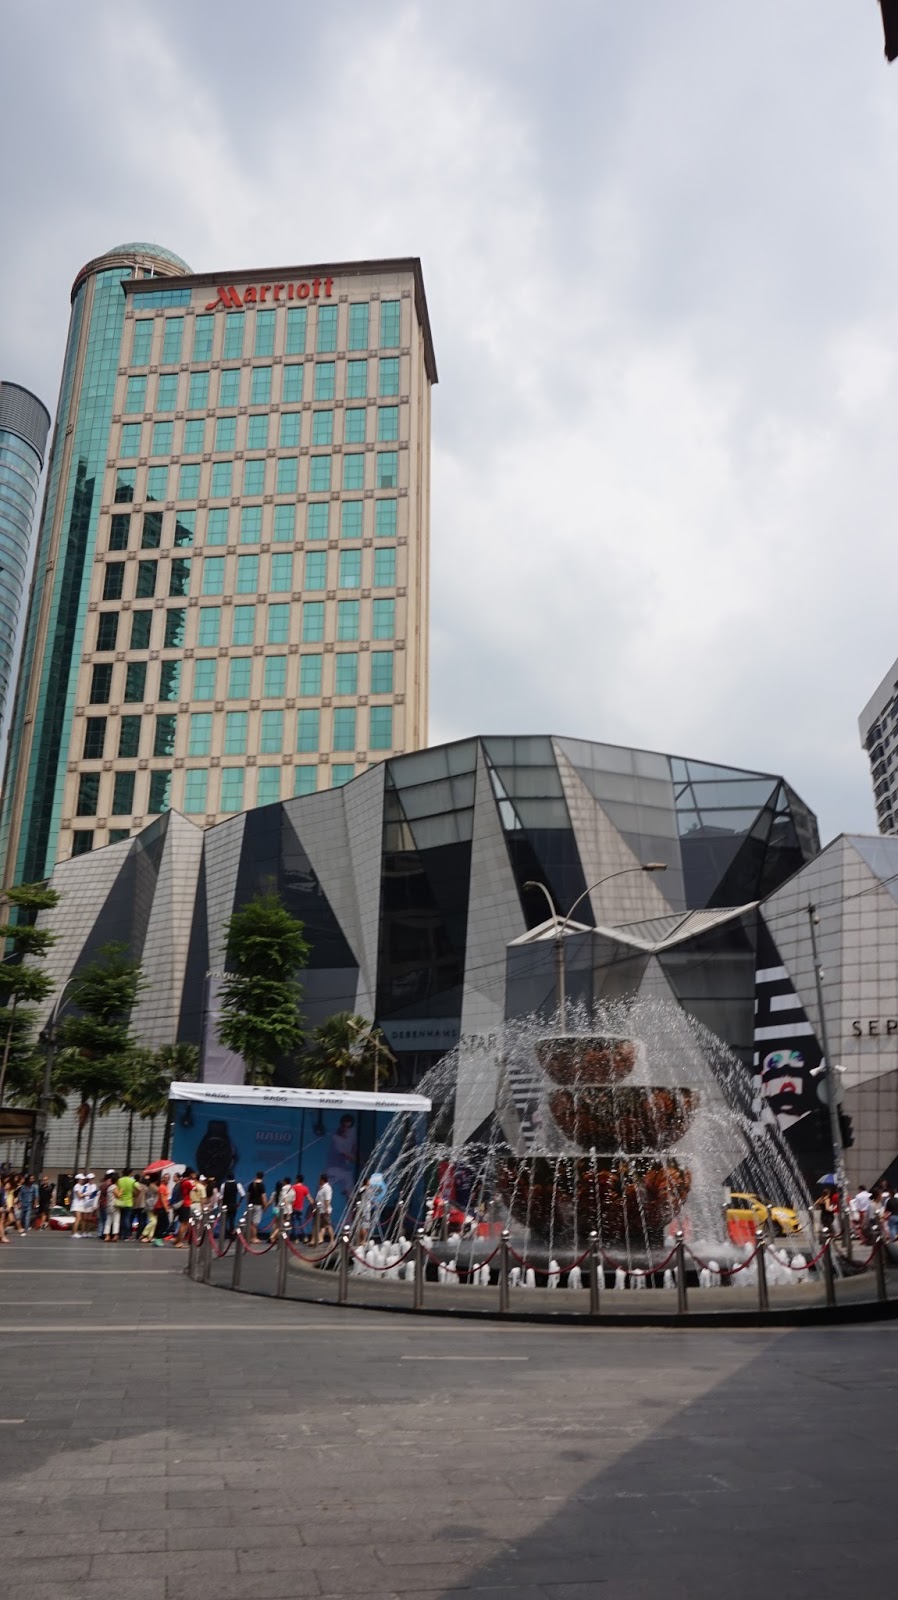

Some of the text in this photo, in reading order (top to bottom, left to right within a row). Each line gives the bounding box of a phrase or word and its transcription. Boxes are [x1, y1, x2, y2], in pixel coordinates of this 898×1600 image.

[205, 277, 333, 310] Marriott
[391, 1029, 457, 1039] DEBENHAMS
[852, 1019, 898, 1037] SEP
[256, 1132, 291, 1141] RADO
